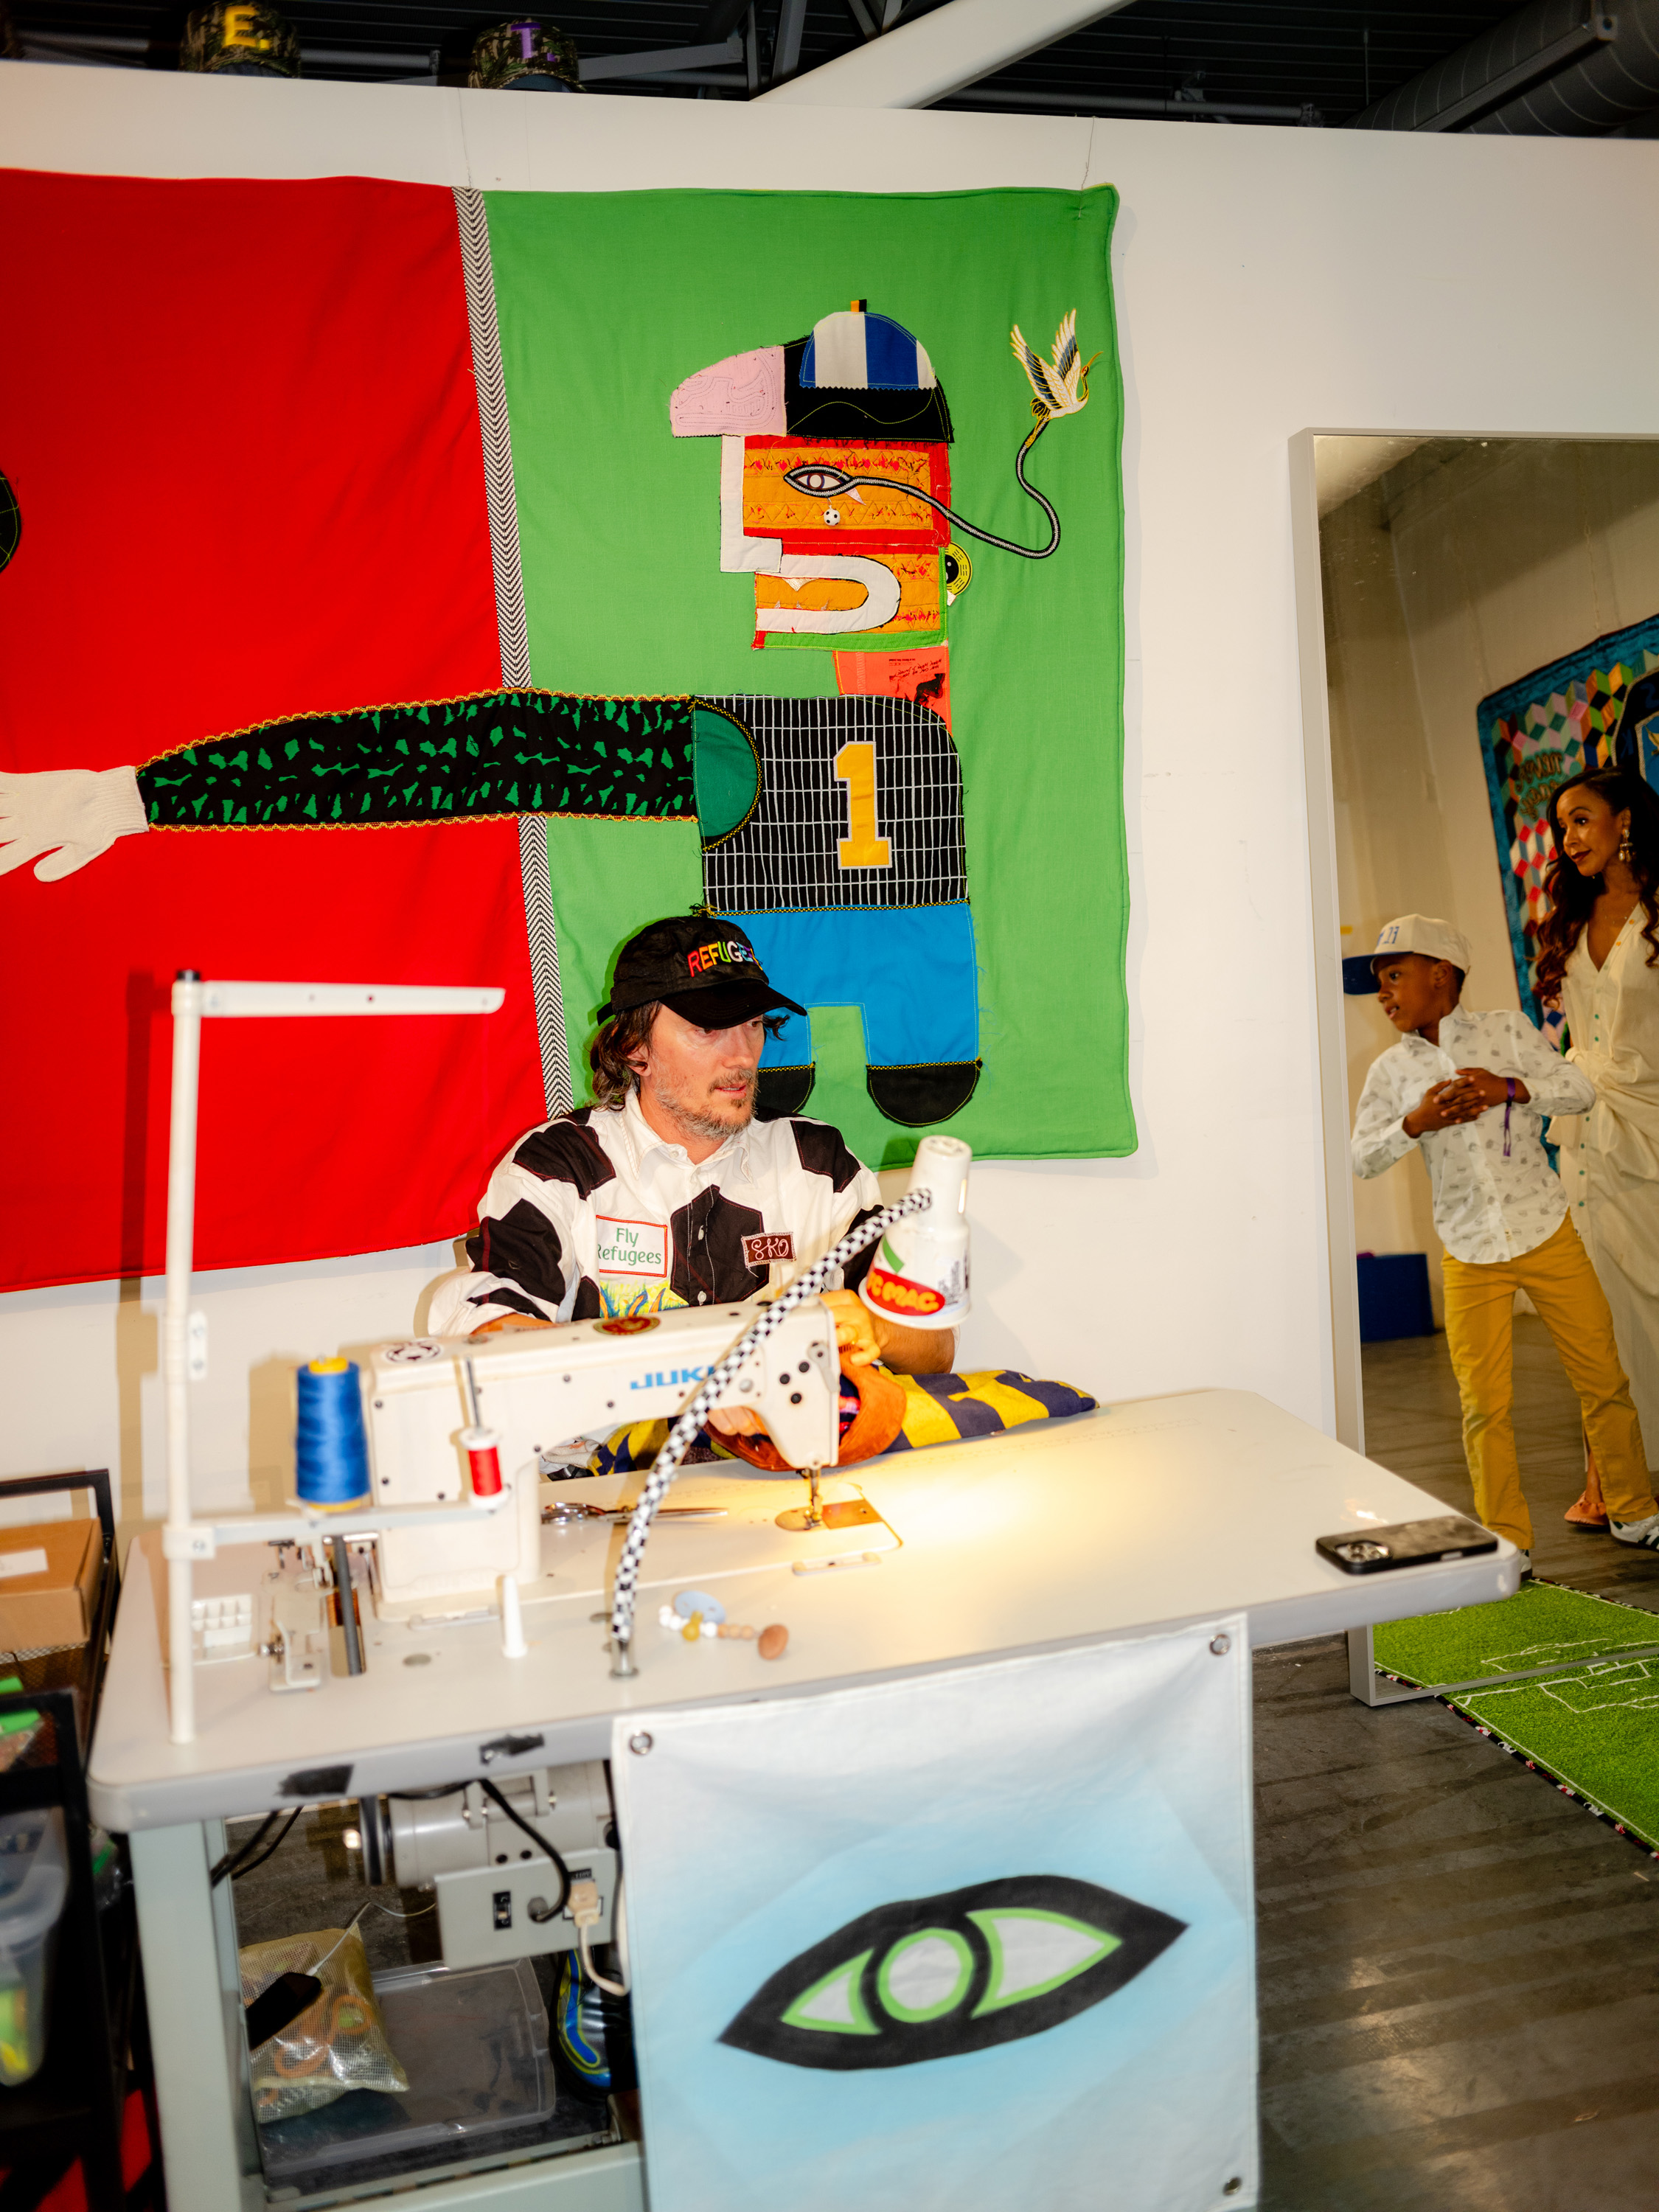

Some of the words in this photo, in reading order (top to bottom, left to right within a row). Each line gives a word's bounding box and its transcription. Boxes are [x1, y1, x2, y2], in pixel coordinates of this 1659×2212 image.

[833, 741, 892, 870] 1
[616, 1227, 639, 1248] Fly
[882, 1281, 939, 1312] MAC
